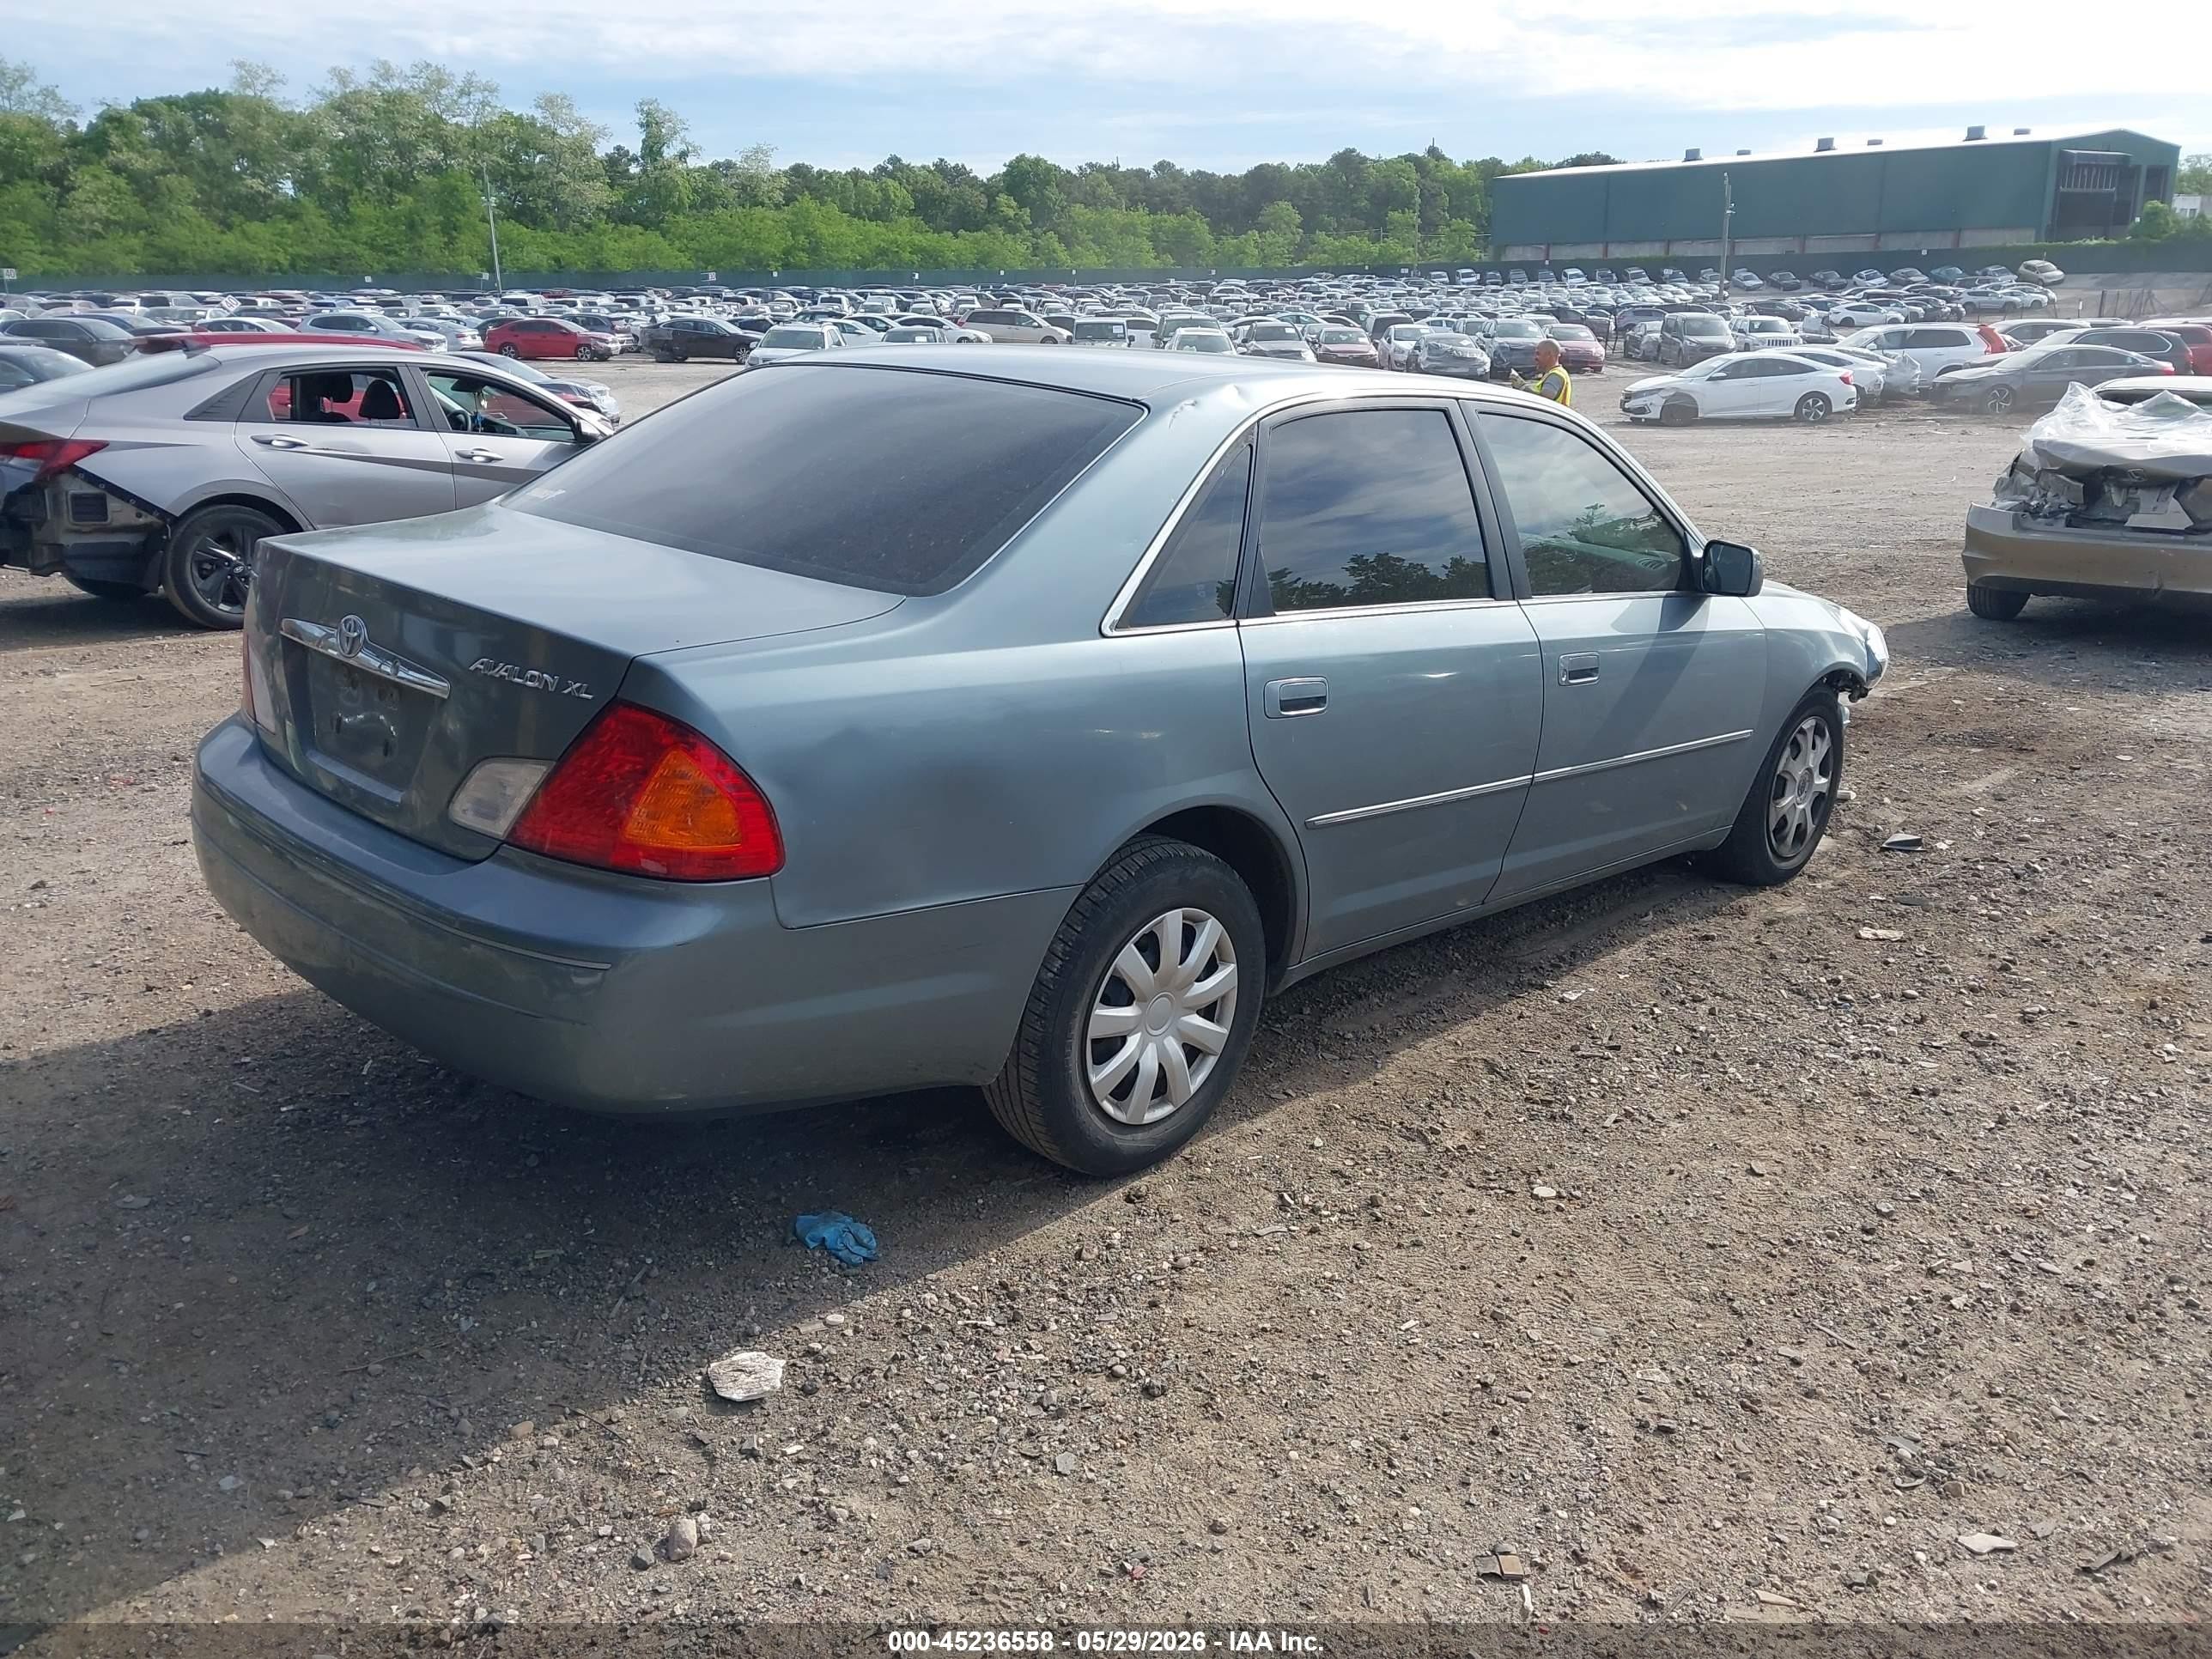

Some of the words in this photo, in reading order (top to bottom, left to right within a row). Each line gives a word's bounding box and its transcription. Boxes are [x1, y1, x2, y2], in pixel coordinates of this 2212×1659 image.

[225, 296, 240, 308] 40
[469, 658, 559, 692] AVALON
[562, 679, 594, 700] XL
